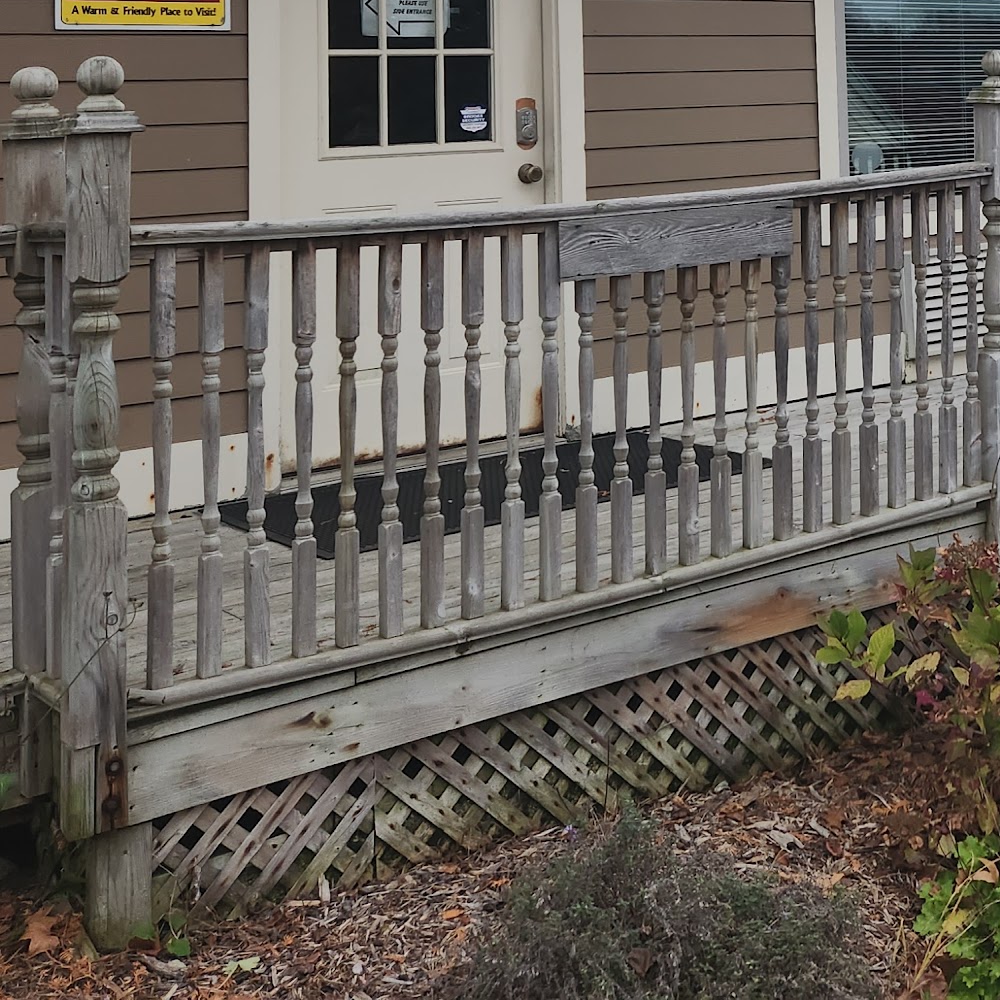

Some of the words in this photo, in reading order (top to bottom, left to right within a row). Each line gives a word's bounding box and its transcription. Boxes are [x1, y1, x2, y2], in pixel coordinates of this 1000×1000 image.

[71, 5, 79, 15] A
[81, 5, 107, 15] Warm
[110, 6, 119, 15] &
[123, 6, 156, 17] Friendly
[160, 7, 181, 16] Place
[184, 8, 193, 16] to
[195, 7, 217, 16] Visit!
